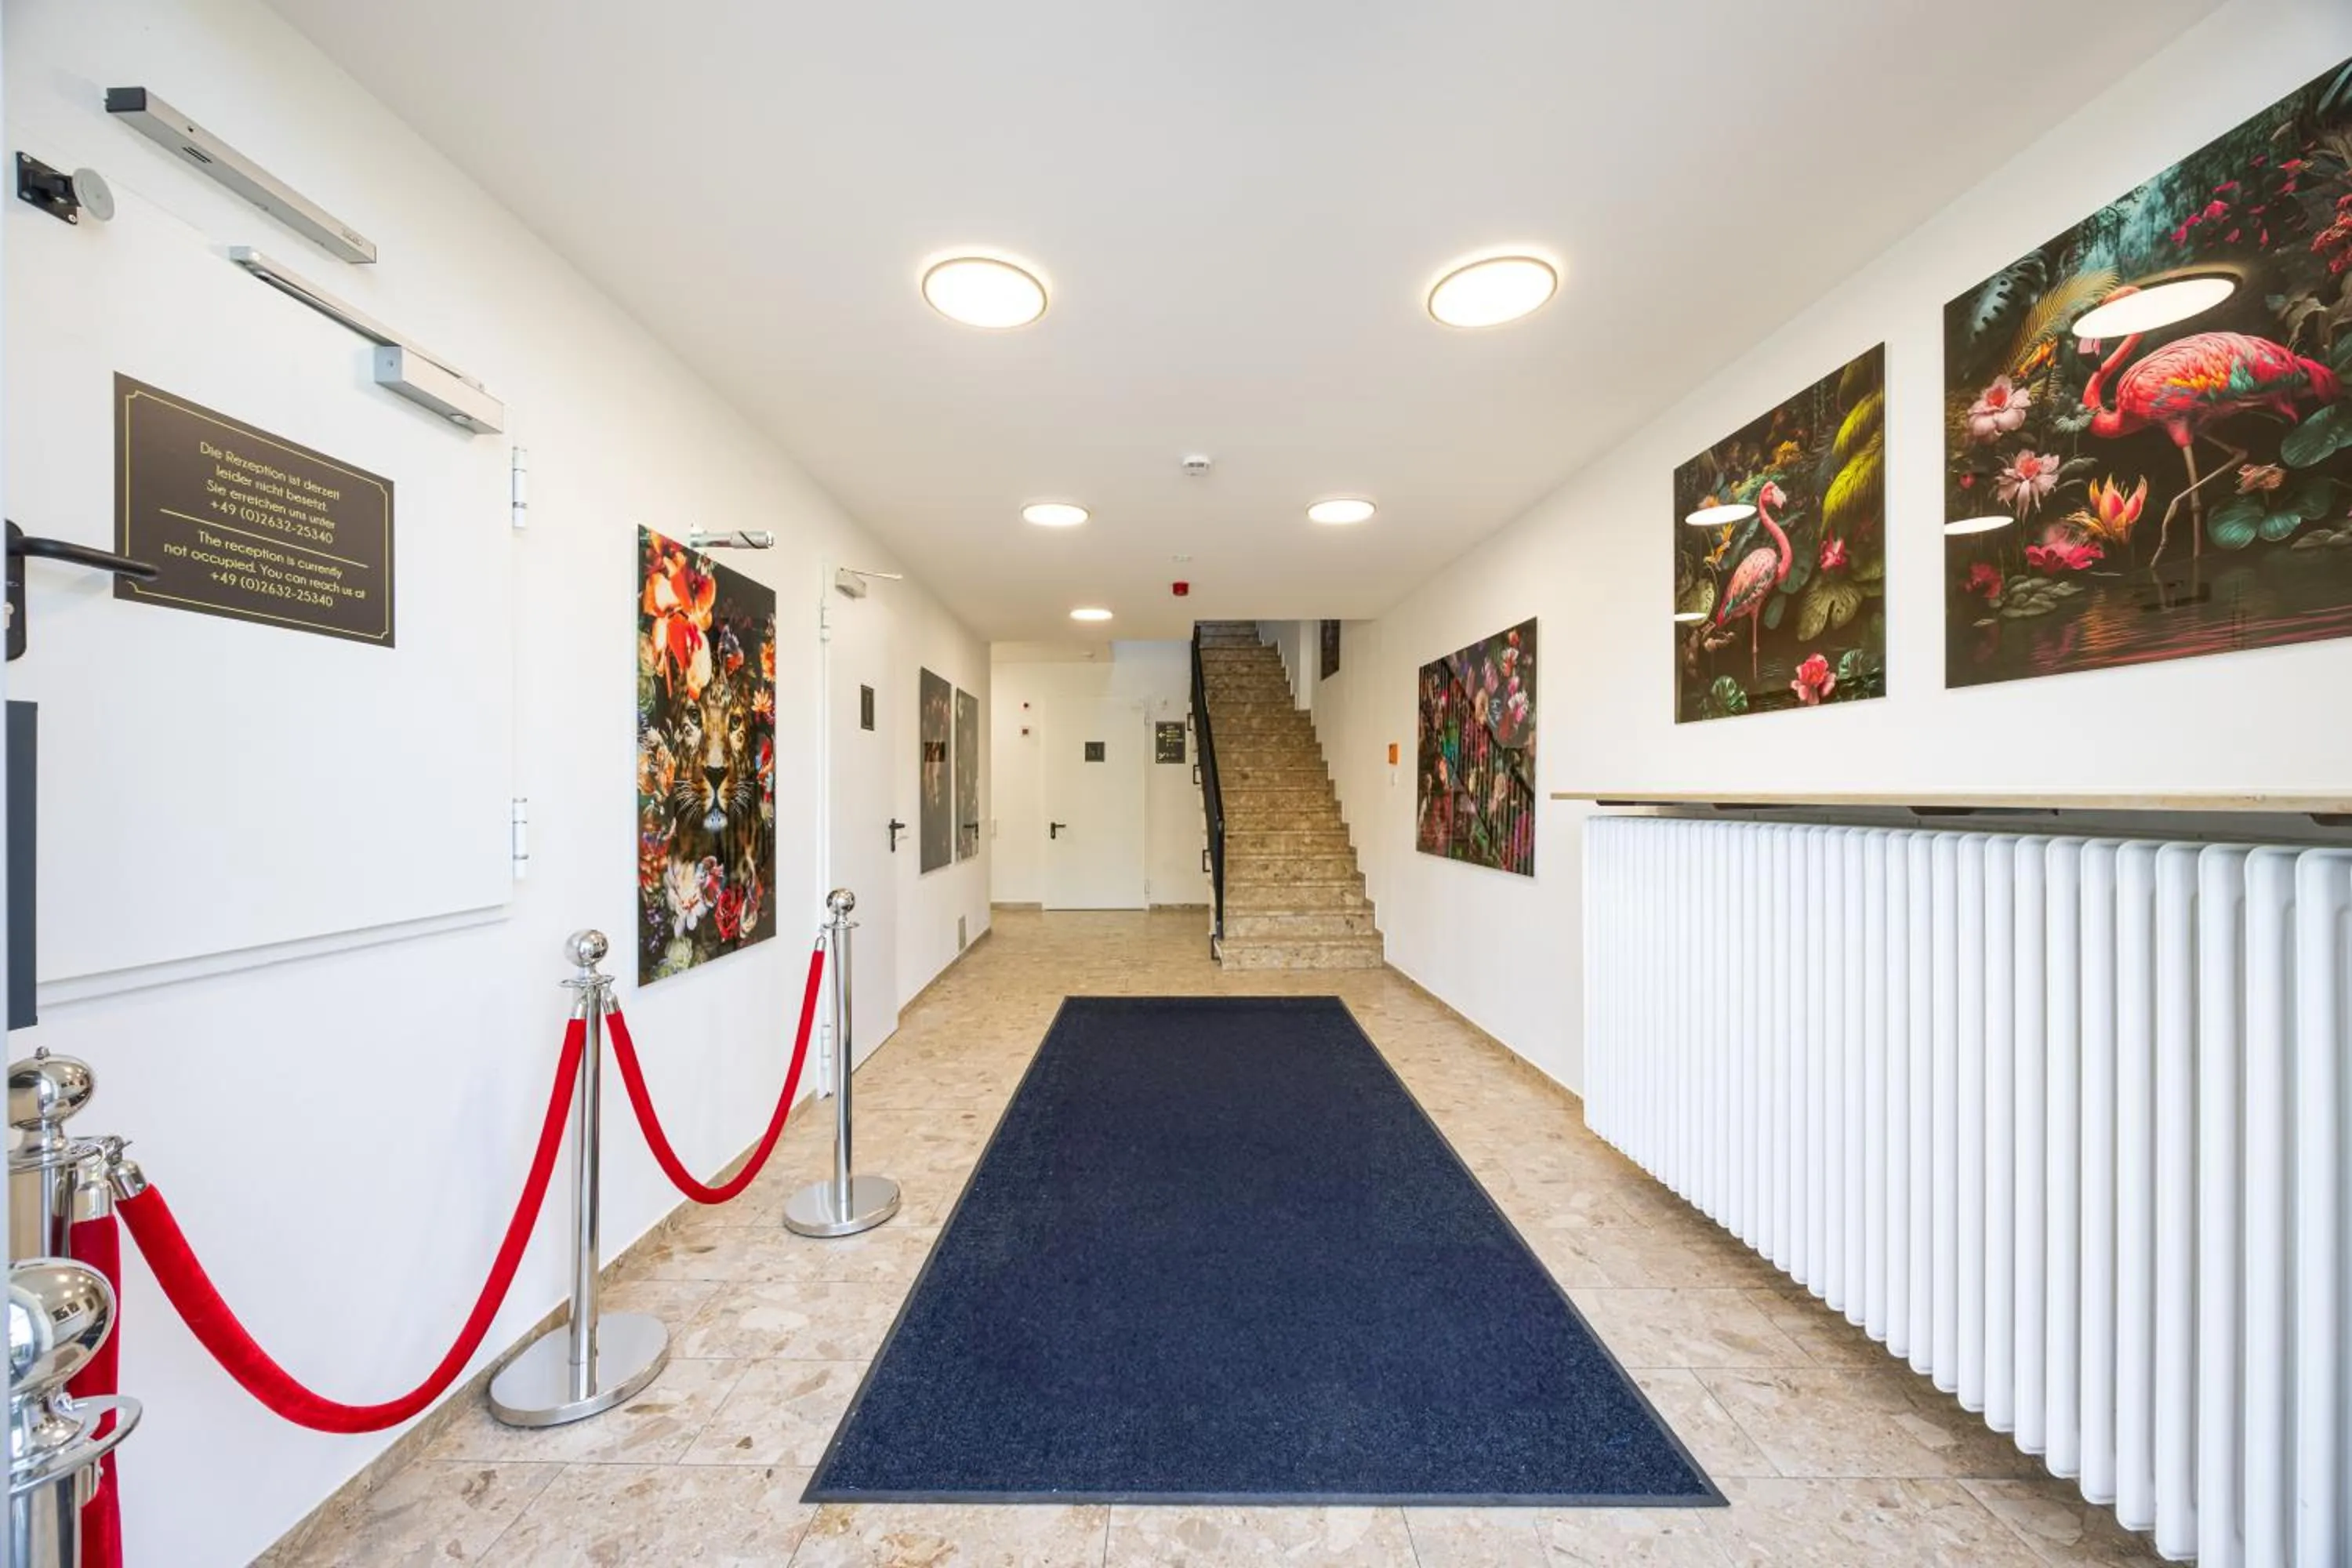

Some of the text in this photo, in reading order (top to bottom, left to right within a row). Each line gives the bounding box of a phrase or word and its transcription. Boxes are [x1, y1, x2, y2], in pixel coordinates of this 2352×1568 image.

[201, 441, 339, 500] Die Rezeption ist derzeit
[216, 464, 252, 486] leider
[256, 481, 283, 497] nicht
[206, 479, 335, 529] Sie erreichen uns unter
[210, 501, 333, 543] +49 (0)2632-25340
[164, 543, 365, 599] not occupied. You can reach us at
[198, 530, 343, 579] The reception is currently
[210, 572, 332, 607] +49 (0)2632-25340
